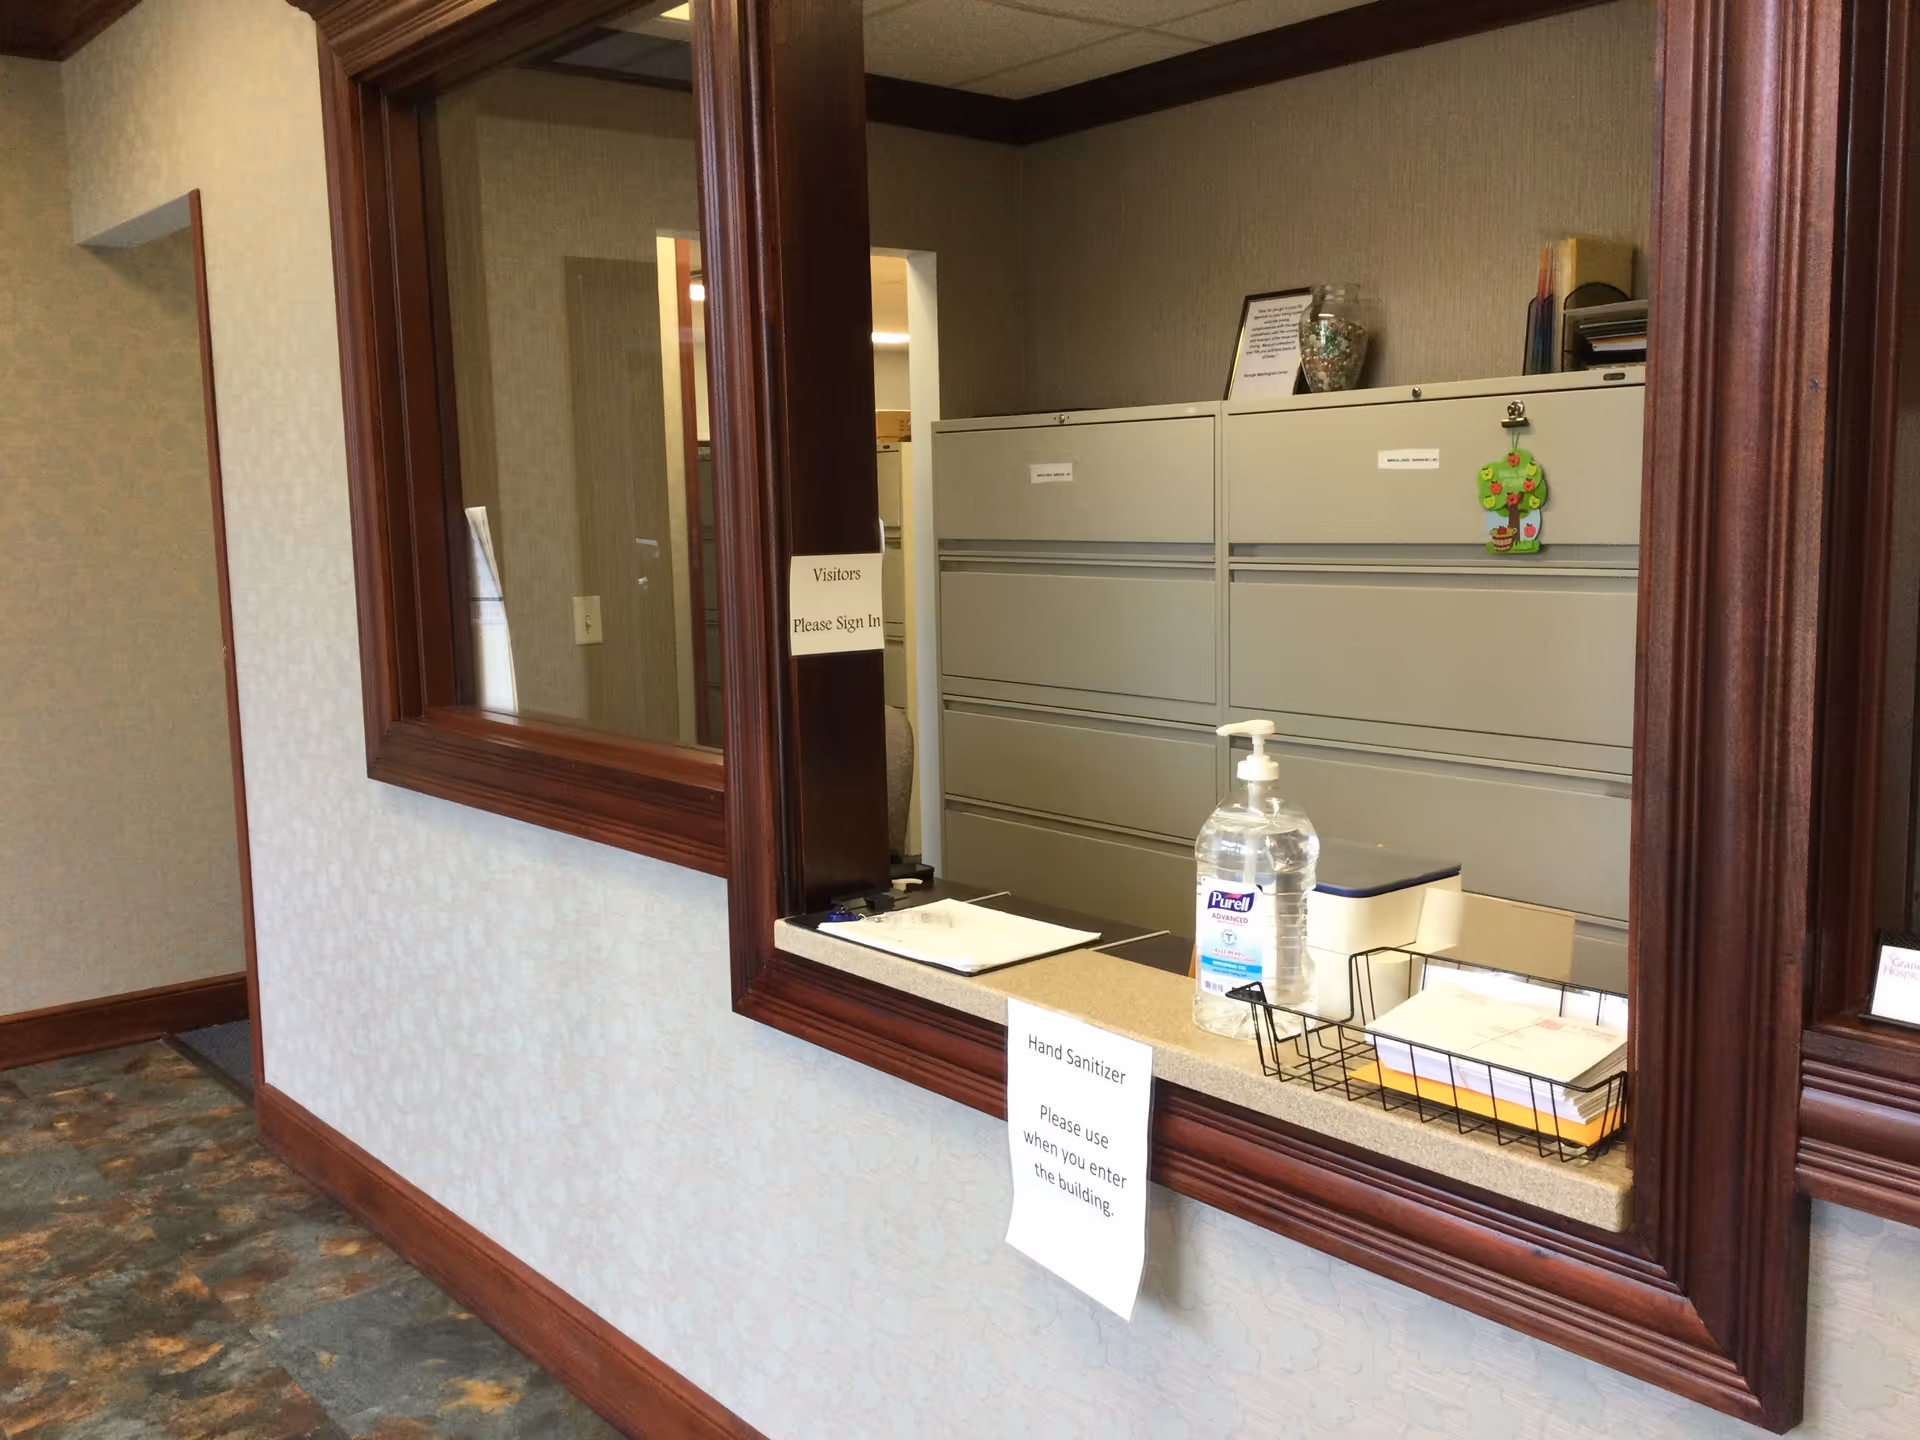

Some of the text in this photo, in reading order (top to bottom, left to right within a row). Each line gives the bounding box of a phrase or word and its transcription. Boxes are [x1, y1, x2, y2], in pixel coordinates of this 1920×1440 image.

[813, 567, 861, 582] Visitors
[793, 613, 881, 633] Please Sign In
[1211, 891, 1251, 912] Purell
[1211, 912, 1249, 924] ADVANCED
[1028, 1033, 1126, 1085] Hand Sanitizer
[1040, 1104, 1109, 1149] Please use
[1023, 1130, 1127, 1189] when you enter
[1034, 1162, 1114, 1218] the building.
